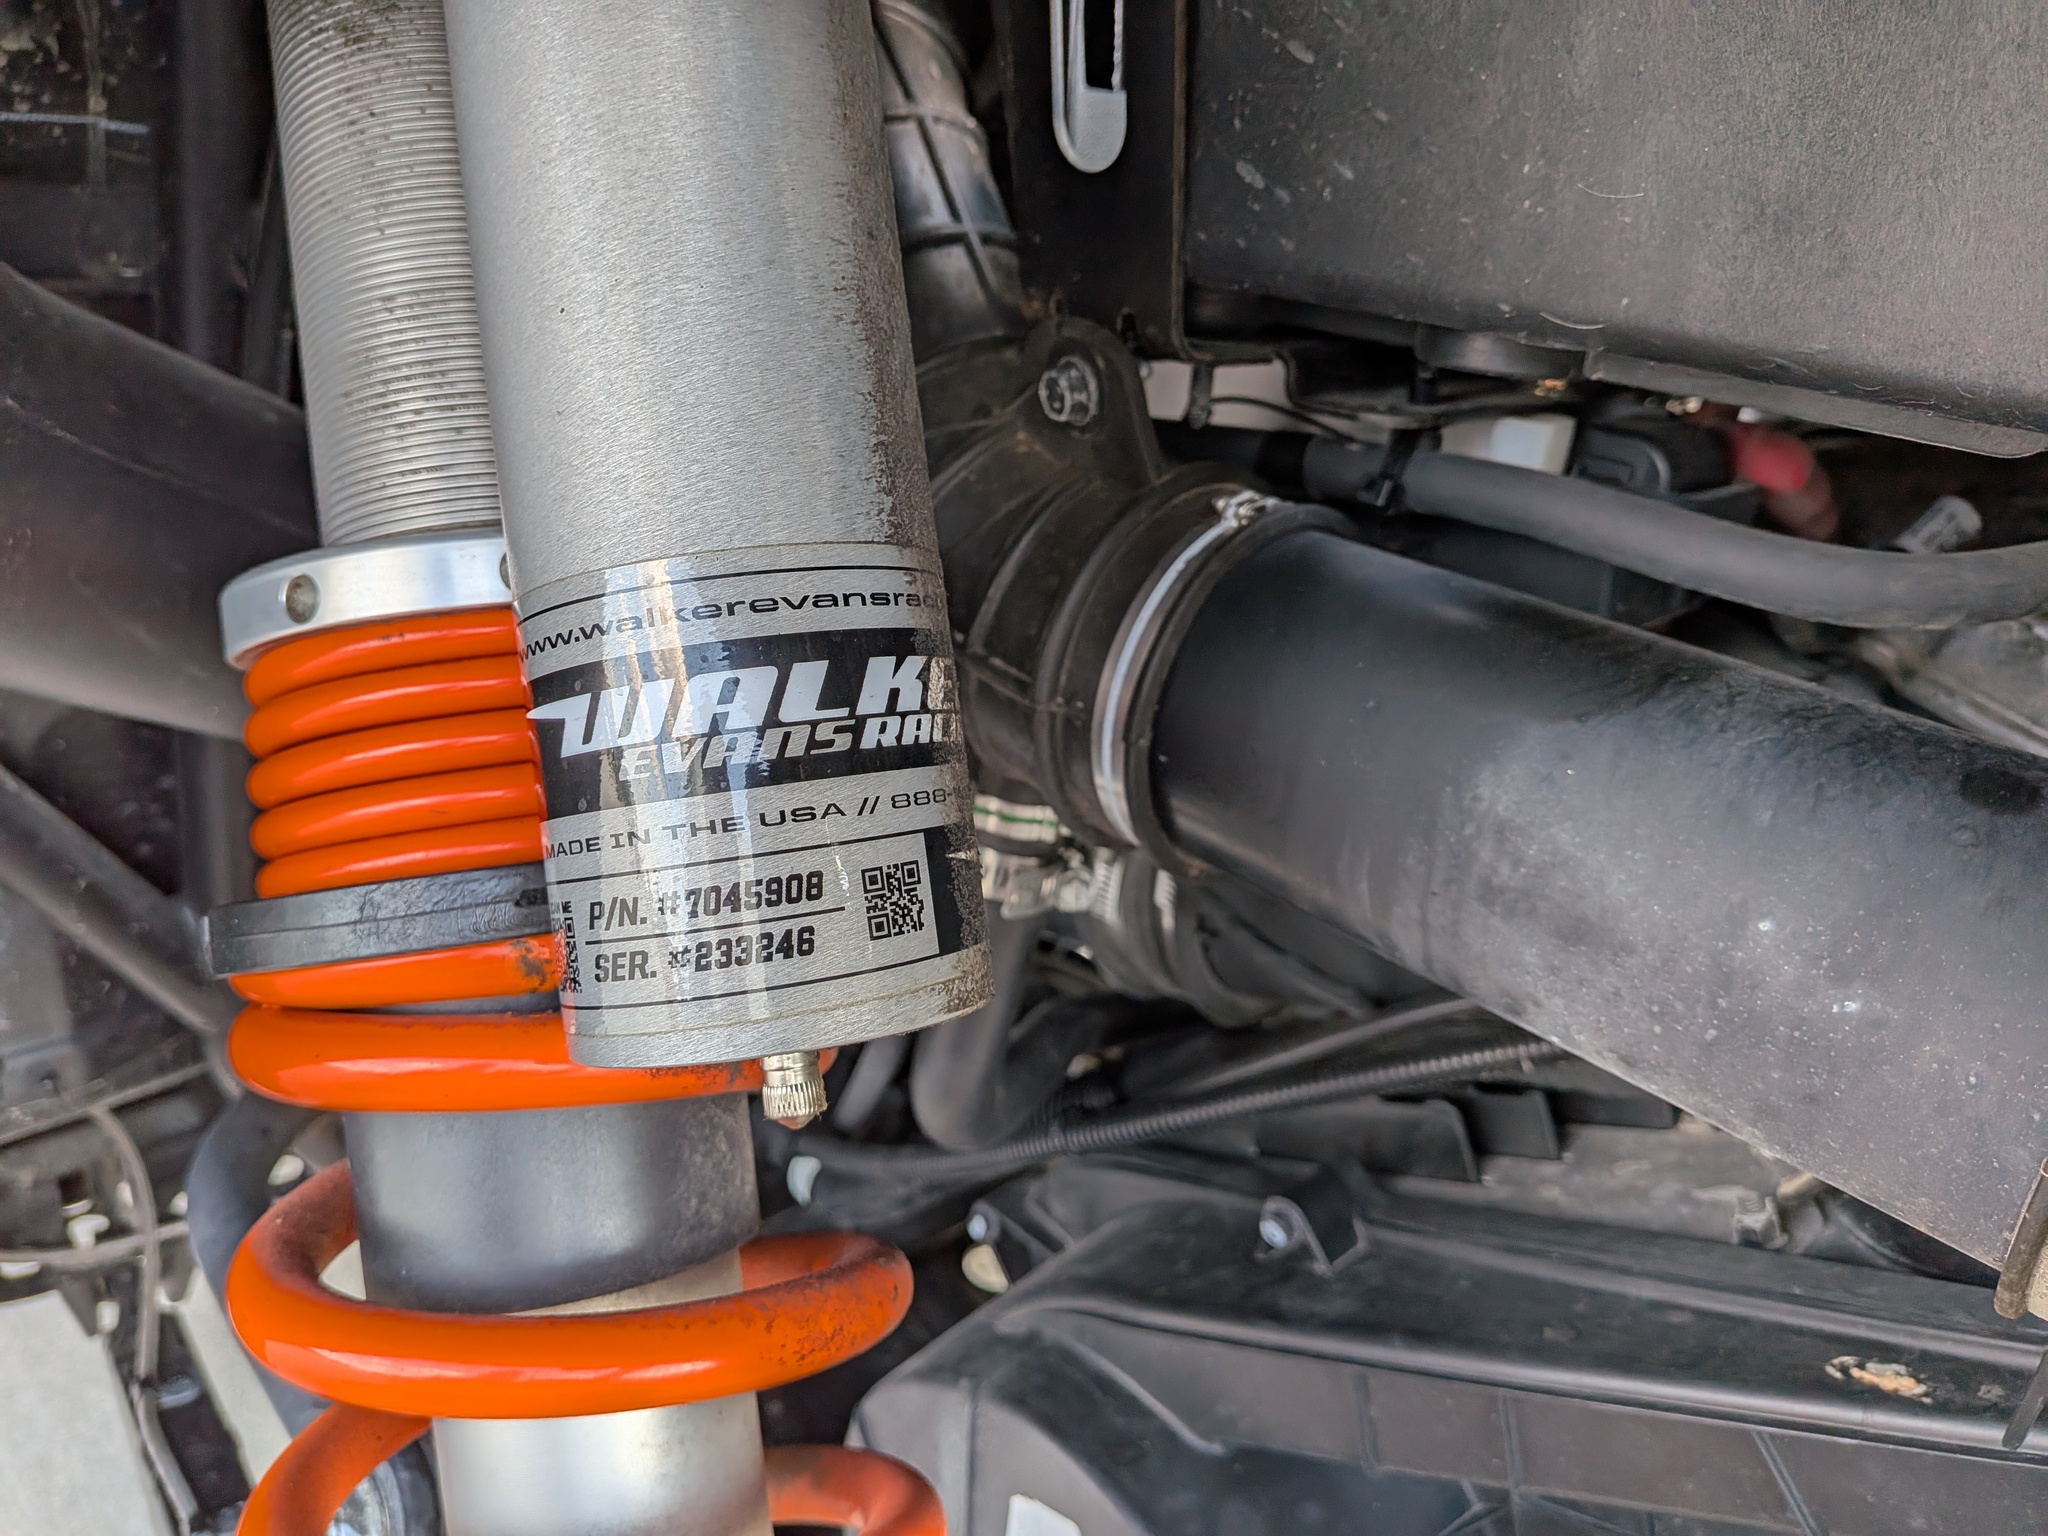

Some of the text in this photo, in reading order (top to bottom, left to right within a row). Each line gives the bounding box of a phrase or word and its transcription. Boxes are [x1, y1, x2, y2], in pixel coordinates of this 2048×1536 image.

[619, 719, 855, 782] EVANS
[545, 836, 601, 859] MADE
[610, 829, 650, 849] IN
[662, 815, 746, 840] THE
[759, 802, 847, 827] USA
[588, 870, 824, 931] P/N. #7045908
[594, 925, 815, 983] SER. #233246
